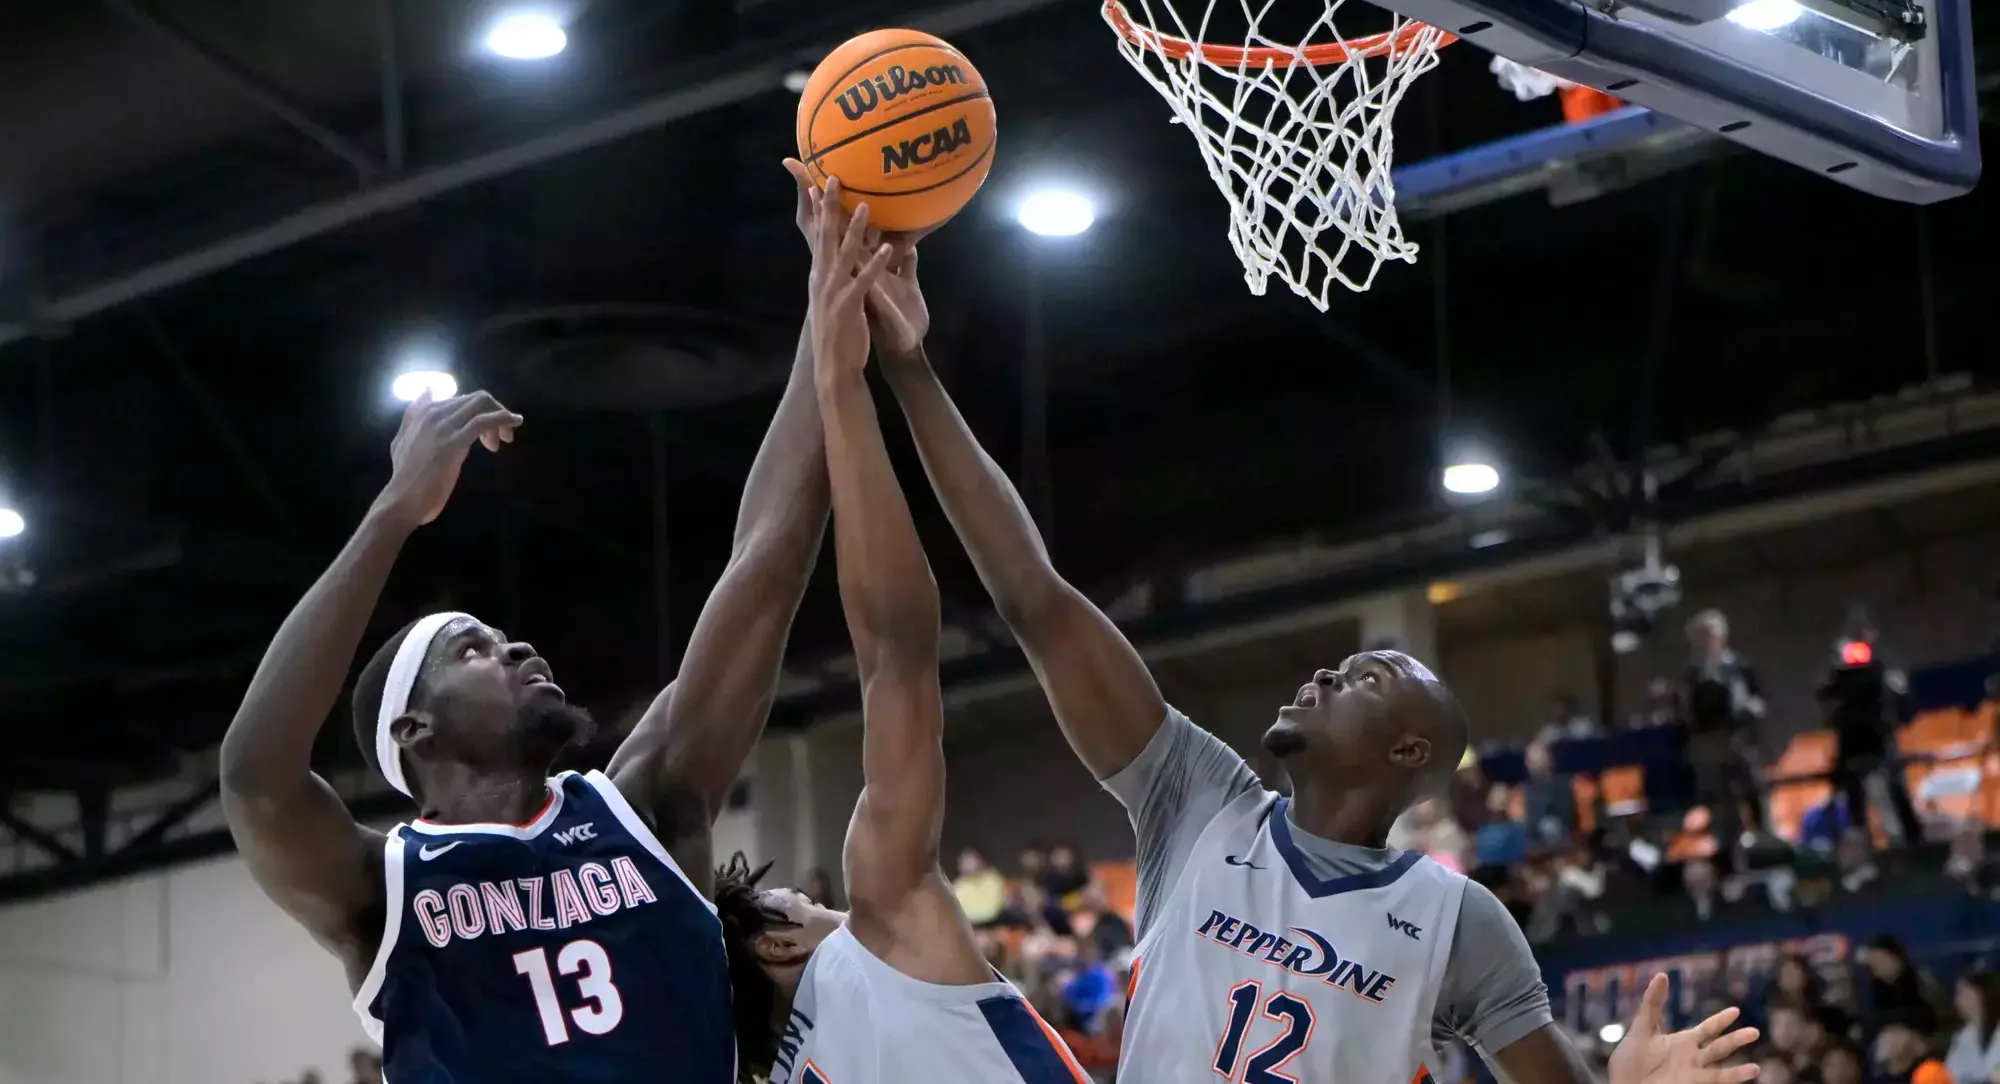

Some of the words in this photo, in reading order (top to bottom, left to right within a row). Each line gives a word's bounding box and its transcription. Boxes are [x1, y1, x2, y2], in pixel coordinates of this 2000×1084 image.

[835, 63, 968, 121] Wilson
[881, 116, 972, 174] NCAA
[552, 821, 598, 846] WCC
[413, 856, 658, 948] GONZAGA
[1386, 912, 1423, 941] WCC
[511, 938, 624, 1047] 13
[1194, 908, 1397, 1004] PEPPERDINE
[1212, 978, 1316, 1084] 12
